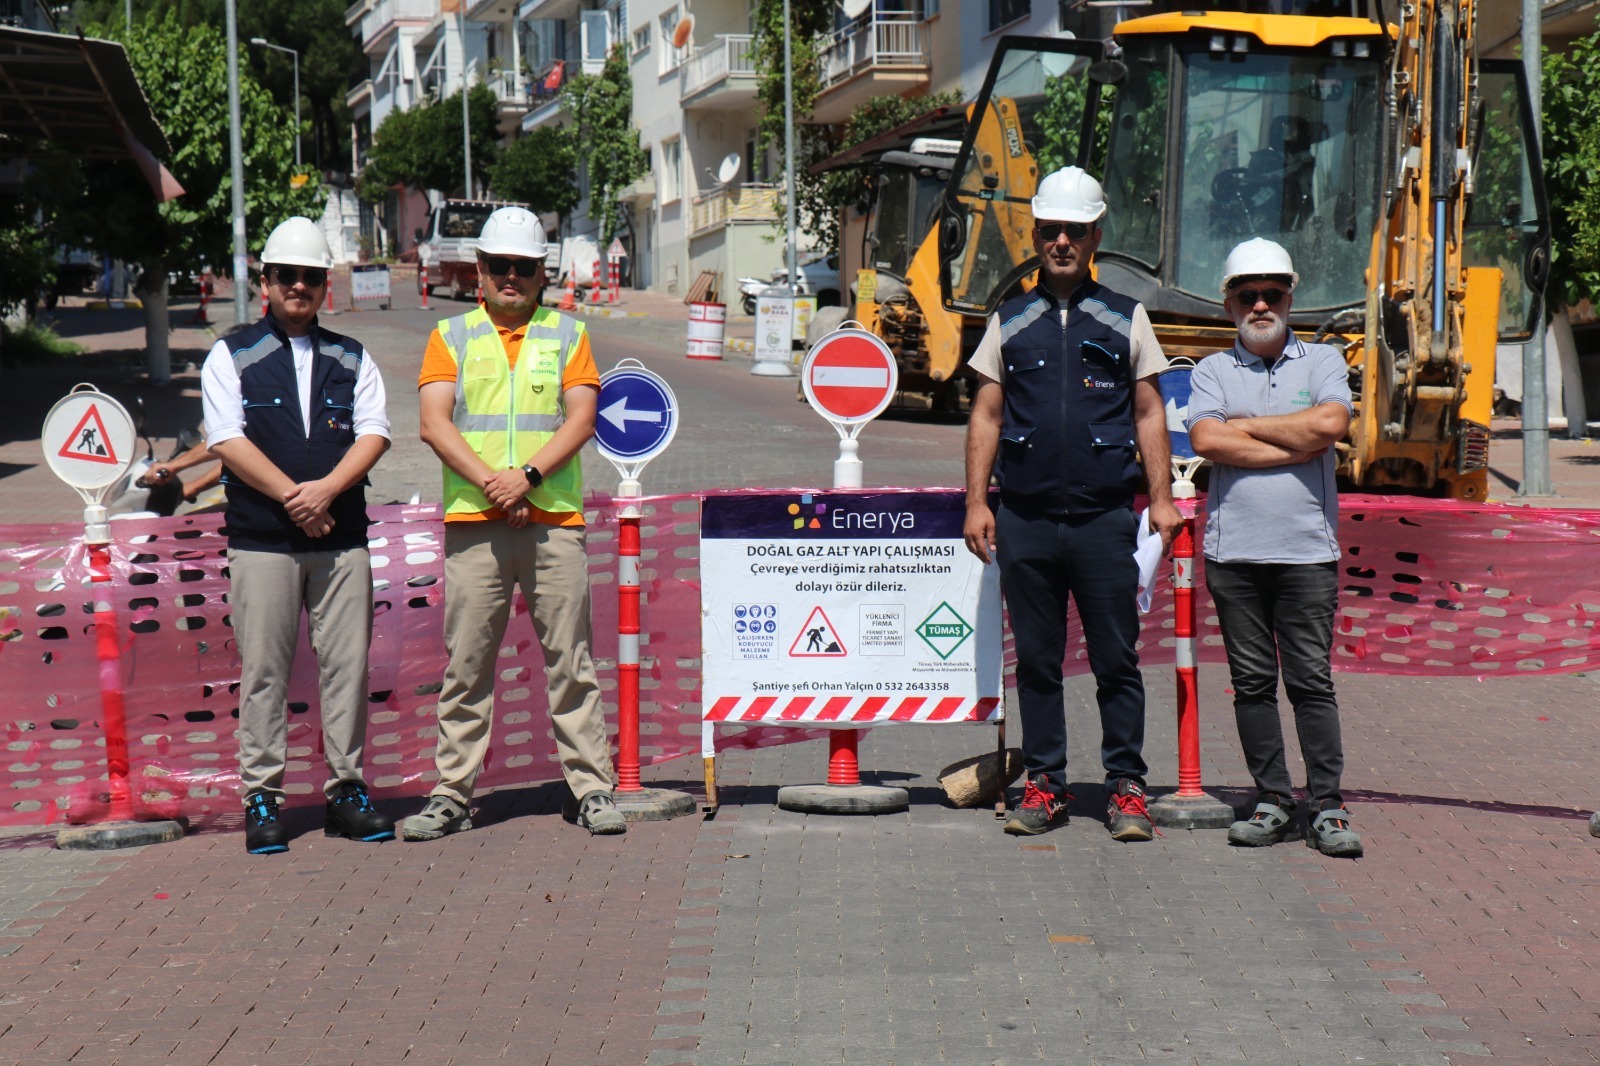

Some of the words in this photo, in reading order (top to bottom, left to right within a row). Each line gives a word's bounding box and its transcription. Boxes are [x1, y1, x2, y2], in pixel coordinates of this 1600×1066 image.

[1095, 380, 1115, 389] Enerya
[832, 508, 915, 534] Enerya
[747, 544, 794, 557] DOĞAL
[796, 545, 824, 557] GAZ
[884, 545, 955, 560] ÇALIŞMASI
[750, 563, 799, 576] Çevreye
[801, 563, 866, 576] verdiğimiz
[868, 563, 952, 574] rahatsızlıktan
[795, 581, 833, 594] dolayı
[835, 581, 863, 592] özür
[865, 581, 907, 592] dileriz.
[865, 612, 900, 620] YÜKLENİCİ
[929, 625, 961, 636] TÜMAŞ
[752, 682, 790, 693] Şantiye
[792, 682, 809, 693] şefi
[811, 682, 843, 691] Orhan
[845, 682, 874, 693] Yalçın
[875, 682, 882, 691] 0
[884, 682, 903, 691] 532
[905, 682, 950, 691] 2643358
